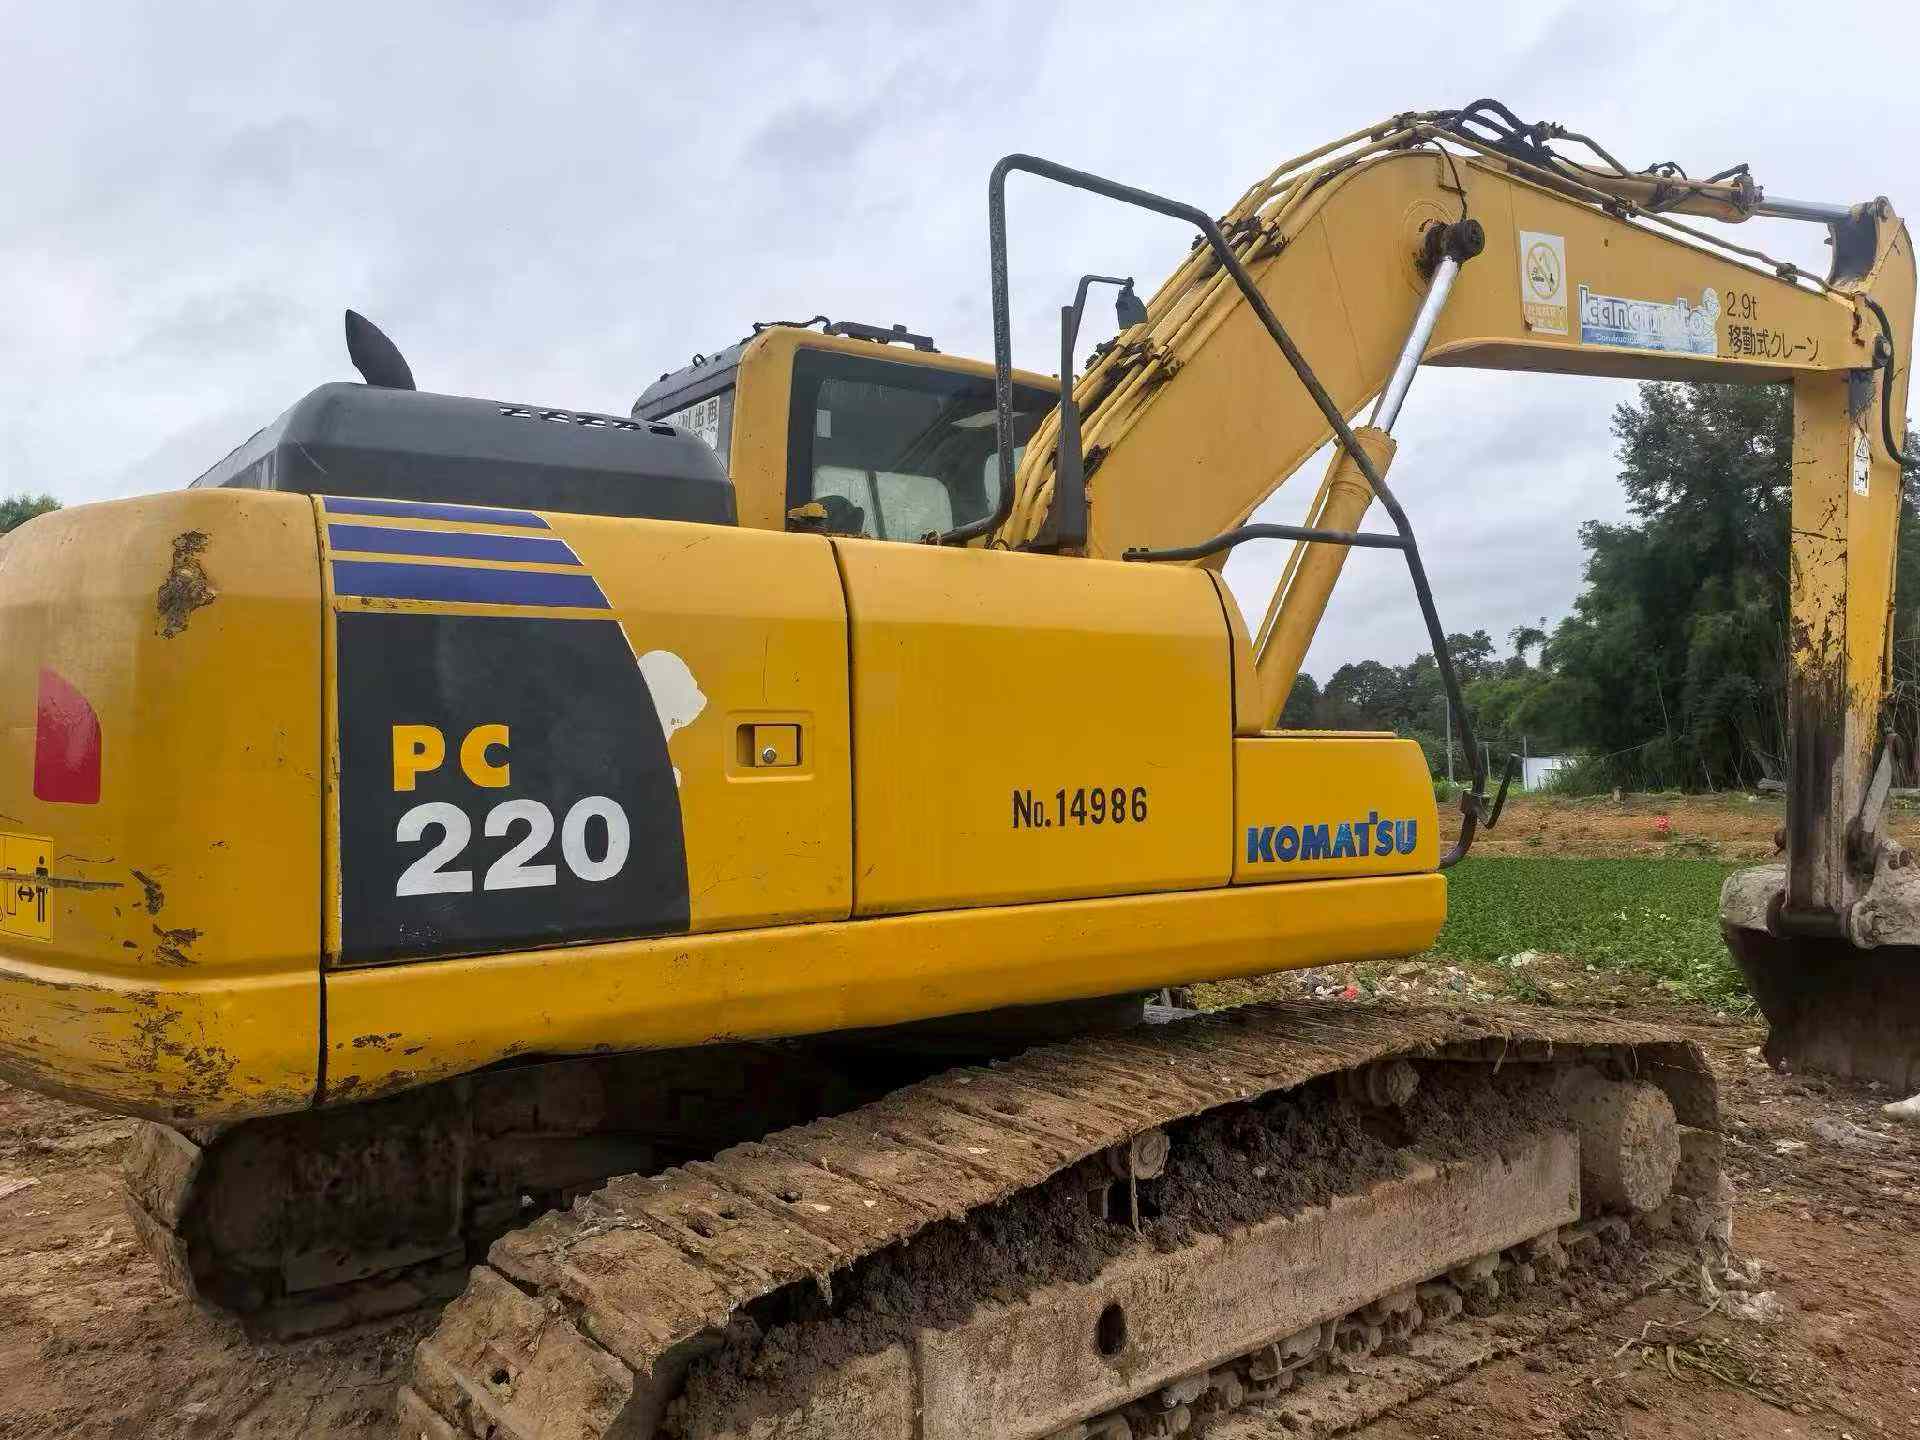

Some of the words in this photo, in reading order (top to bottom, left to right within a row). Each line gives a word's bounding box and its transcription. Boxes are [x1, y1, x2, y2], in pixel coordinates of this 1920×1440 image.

[1726, 290, 1758, 320] 2.9t
[1728, 324, 1820, 361] 移動式クレーン
[393, 724, 511, 791] PC
[396, 795, 631, 897] 220
[1247, 811, 1417, 863] KOMATSU
